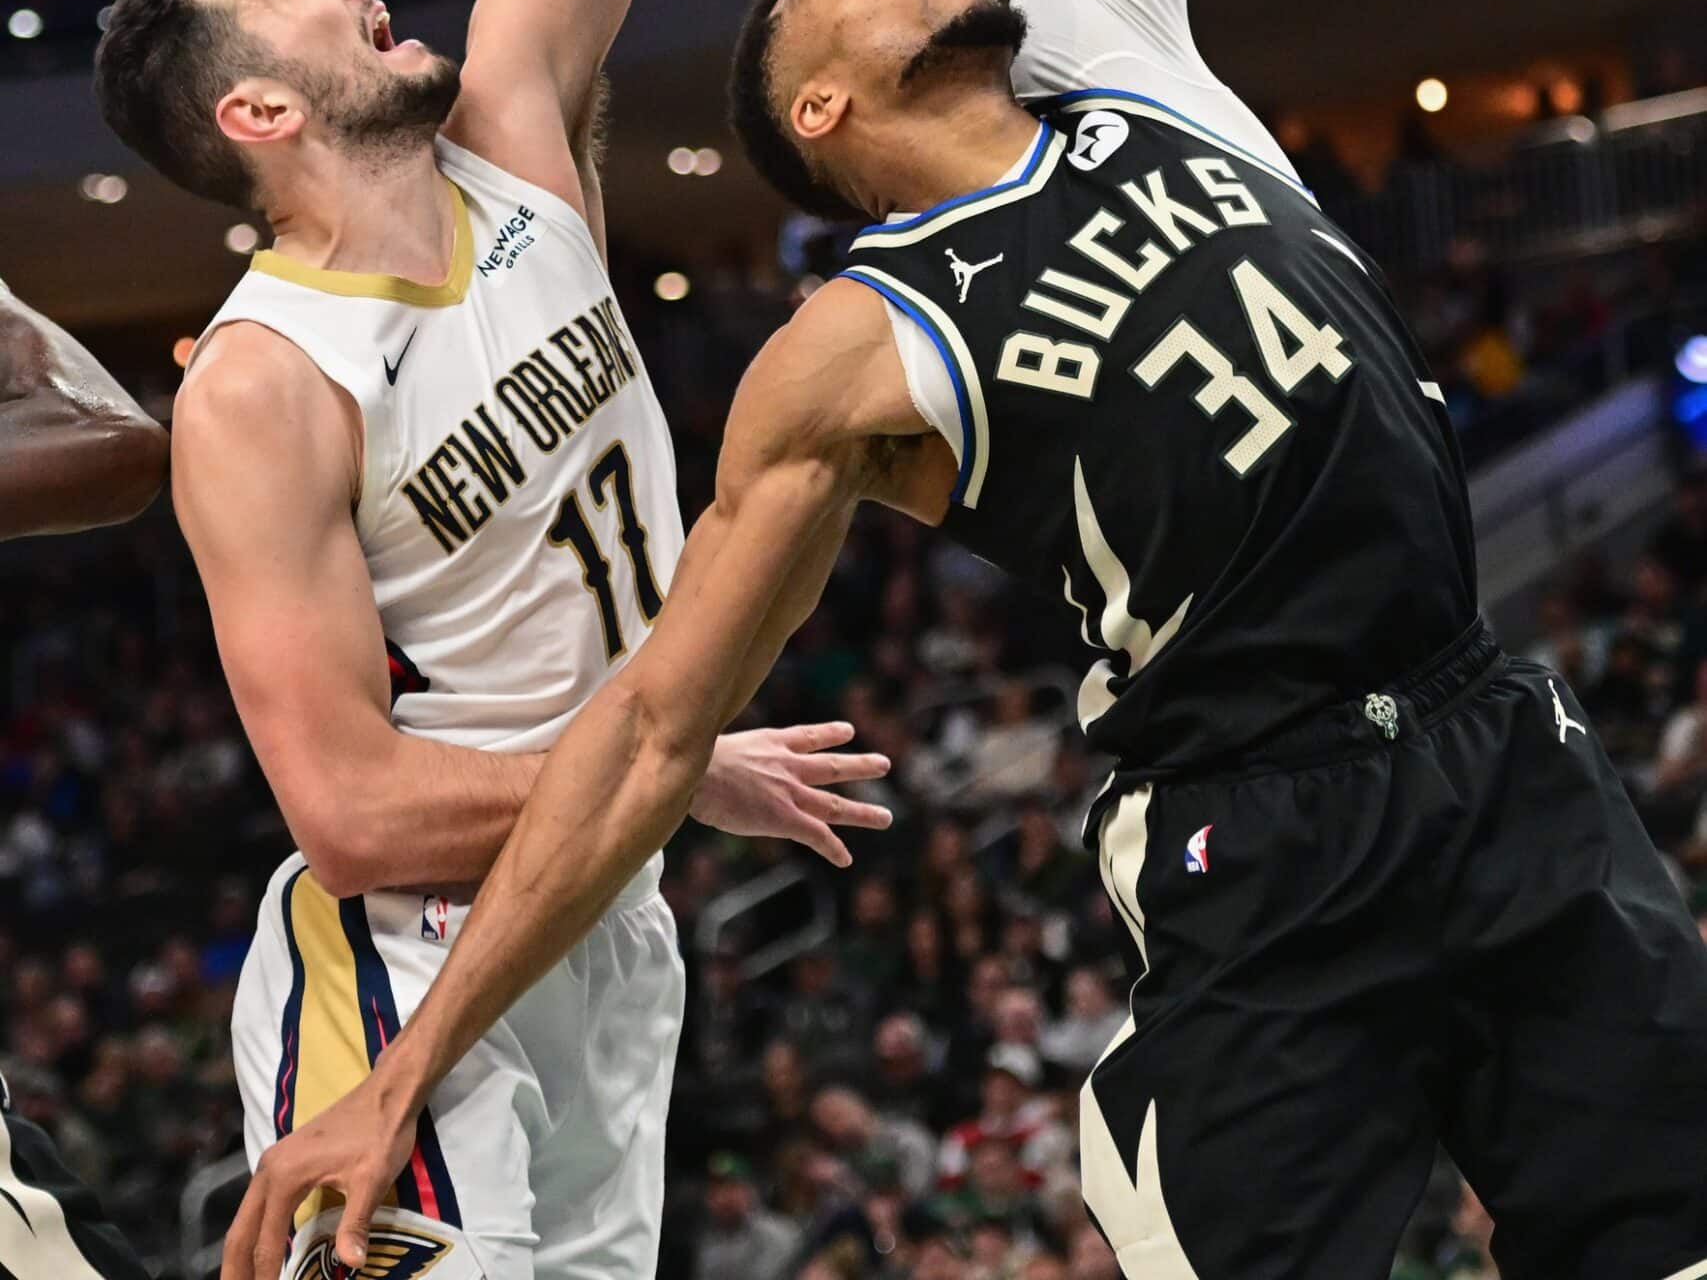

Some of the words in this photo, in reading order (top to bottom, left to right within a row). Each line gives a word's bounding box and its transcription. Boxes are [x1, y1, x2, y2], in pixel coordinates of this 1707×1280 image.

[505, 234, 536, 269] GRILLS
[995, 156, 1272, 402] BUCKS
[401, 402, 528, 557] NEW
[494, 295, 641, 456] ORLEAN
[1127, 254, 1359, 480] 34
[544, 438, 669, 666] 17
